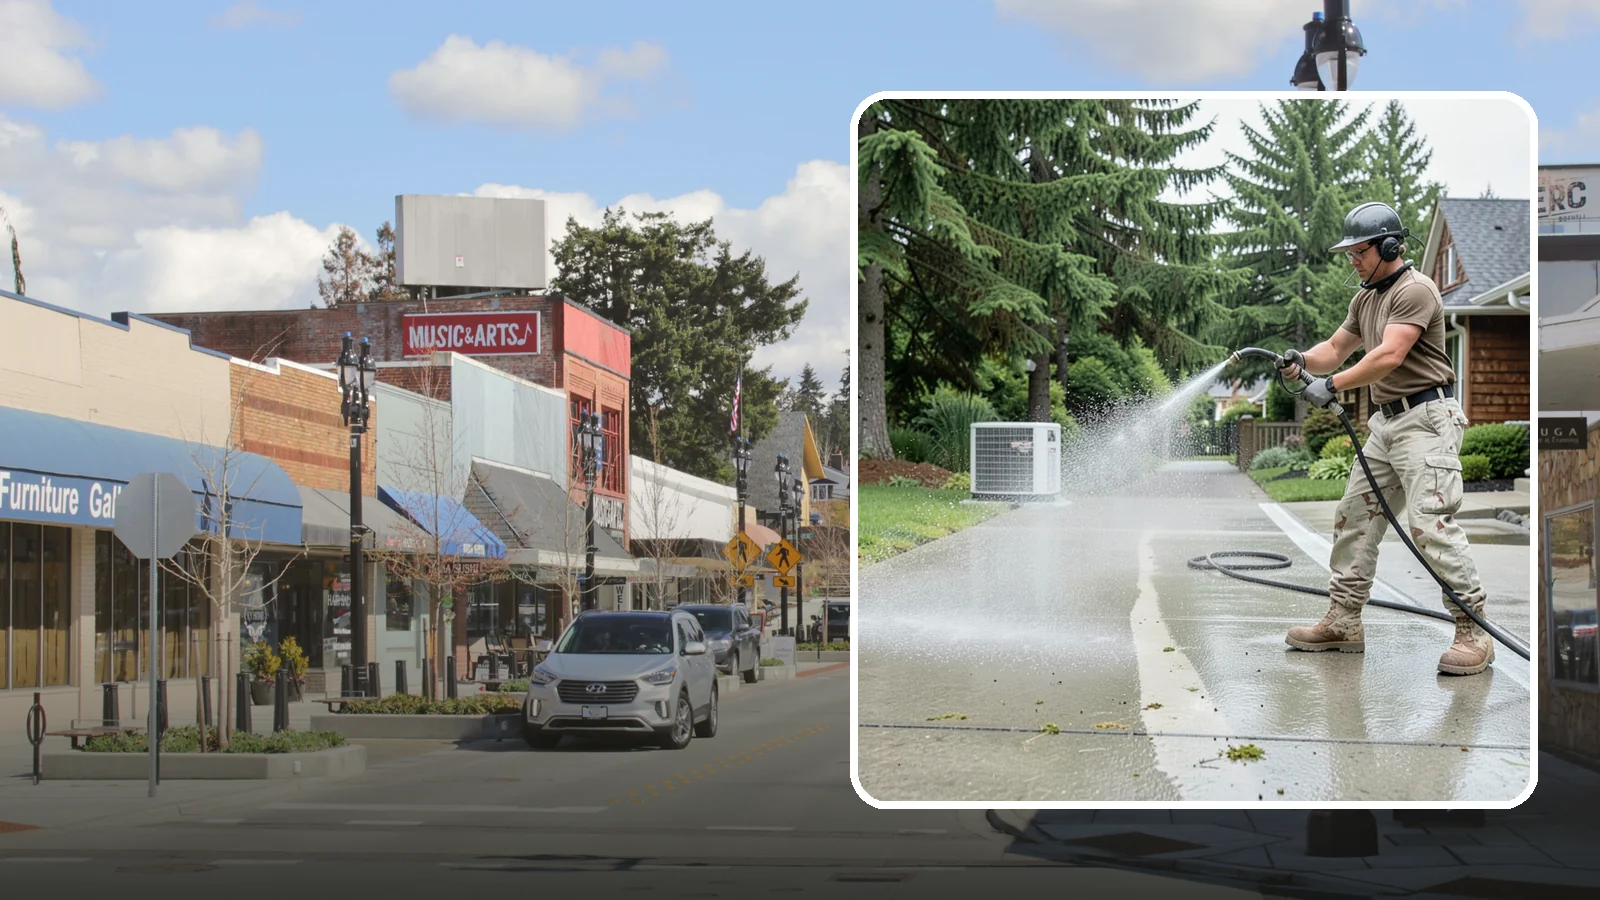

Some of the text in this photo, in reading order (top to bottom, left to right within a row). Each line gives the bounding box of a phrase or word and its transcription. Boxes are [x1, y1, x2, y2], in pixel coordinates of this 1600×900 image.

[0, 471, 122, 519] Furniture Gal
[454, 563, 479, 574] SUSHI
